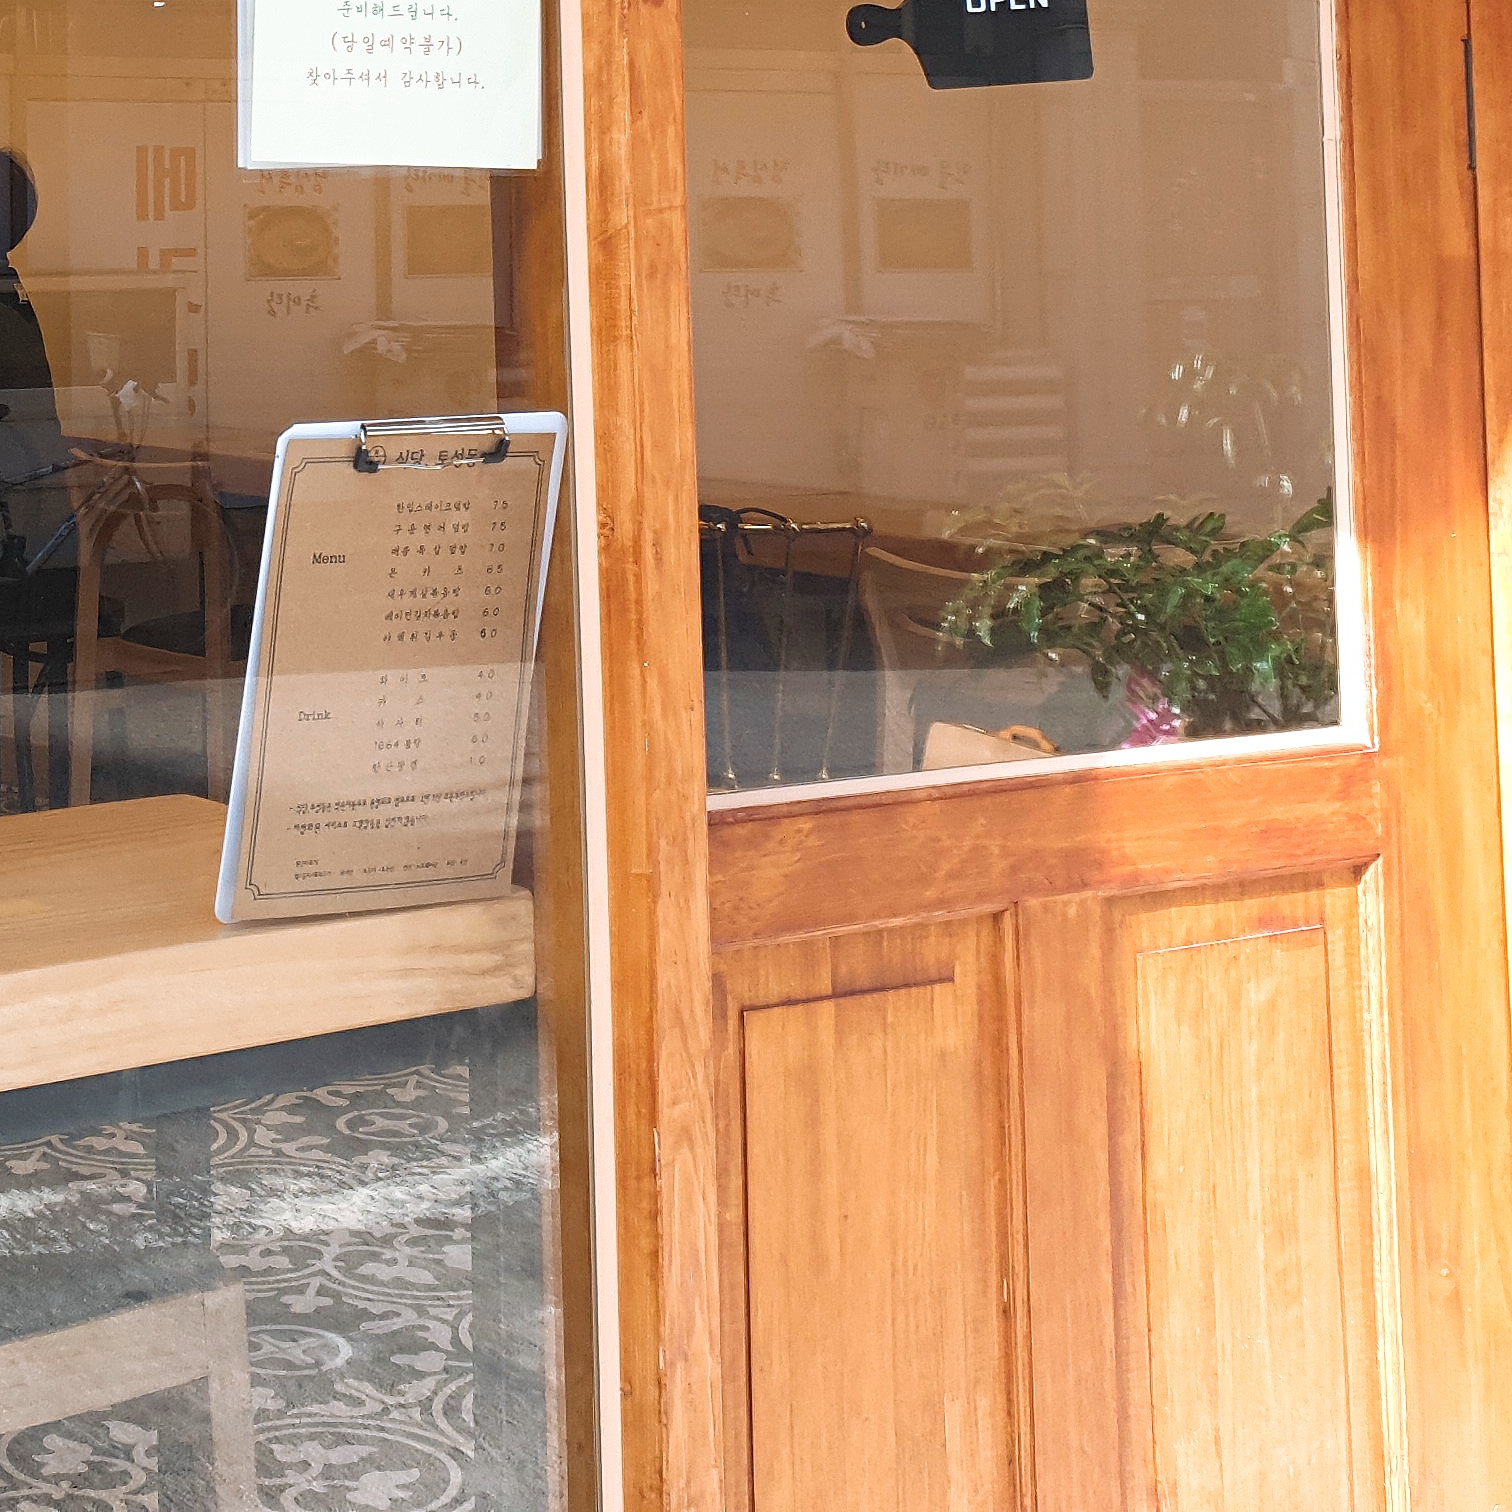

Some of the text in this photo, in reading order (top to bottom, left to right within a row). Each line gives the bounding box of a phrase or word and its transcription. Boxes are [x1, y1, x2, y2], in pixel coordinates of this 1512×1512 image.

[336, 0, 459, 21] 준비해드립니다.
[331, 31, 463, 57] (당일예약불가)
[306, 66, 485, 90] 찾아주셔서 감사합니다.
[311, 552, 346, 565] Menu
[297, 709, 332, 722] Drink
